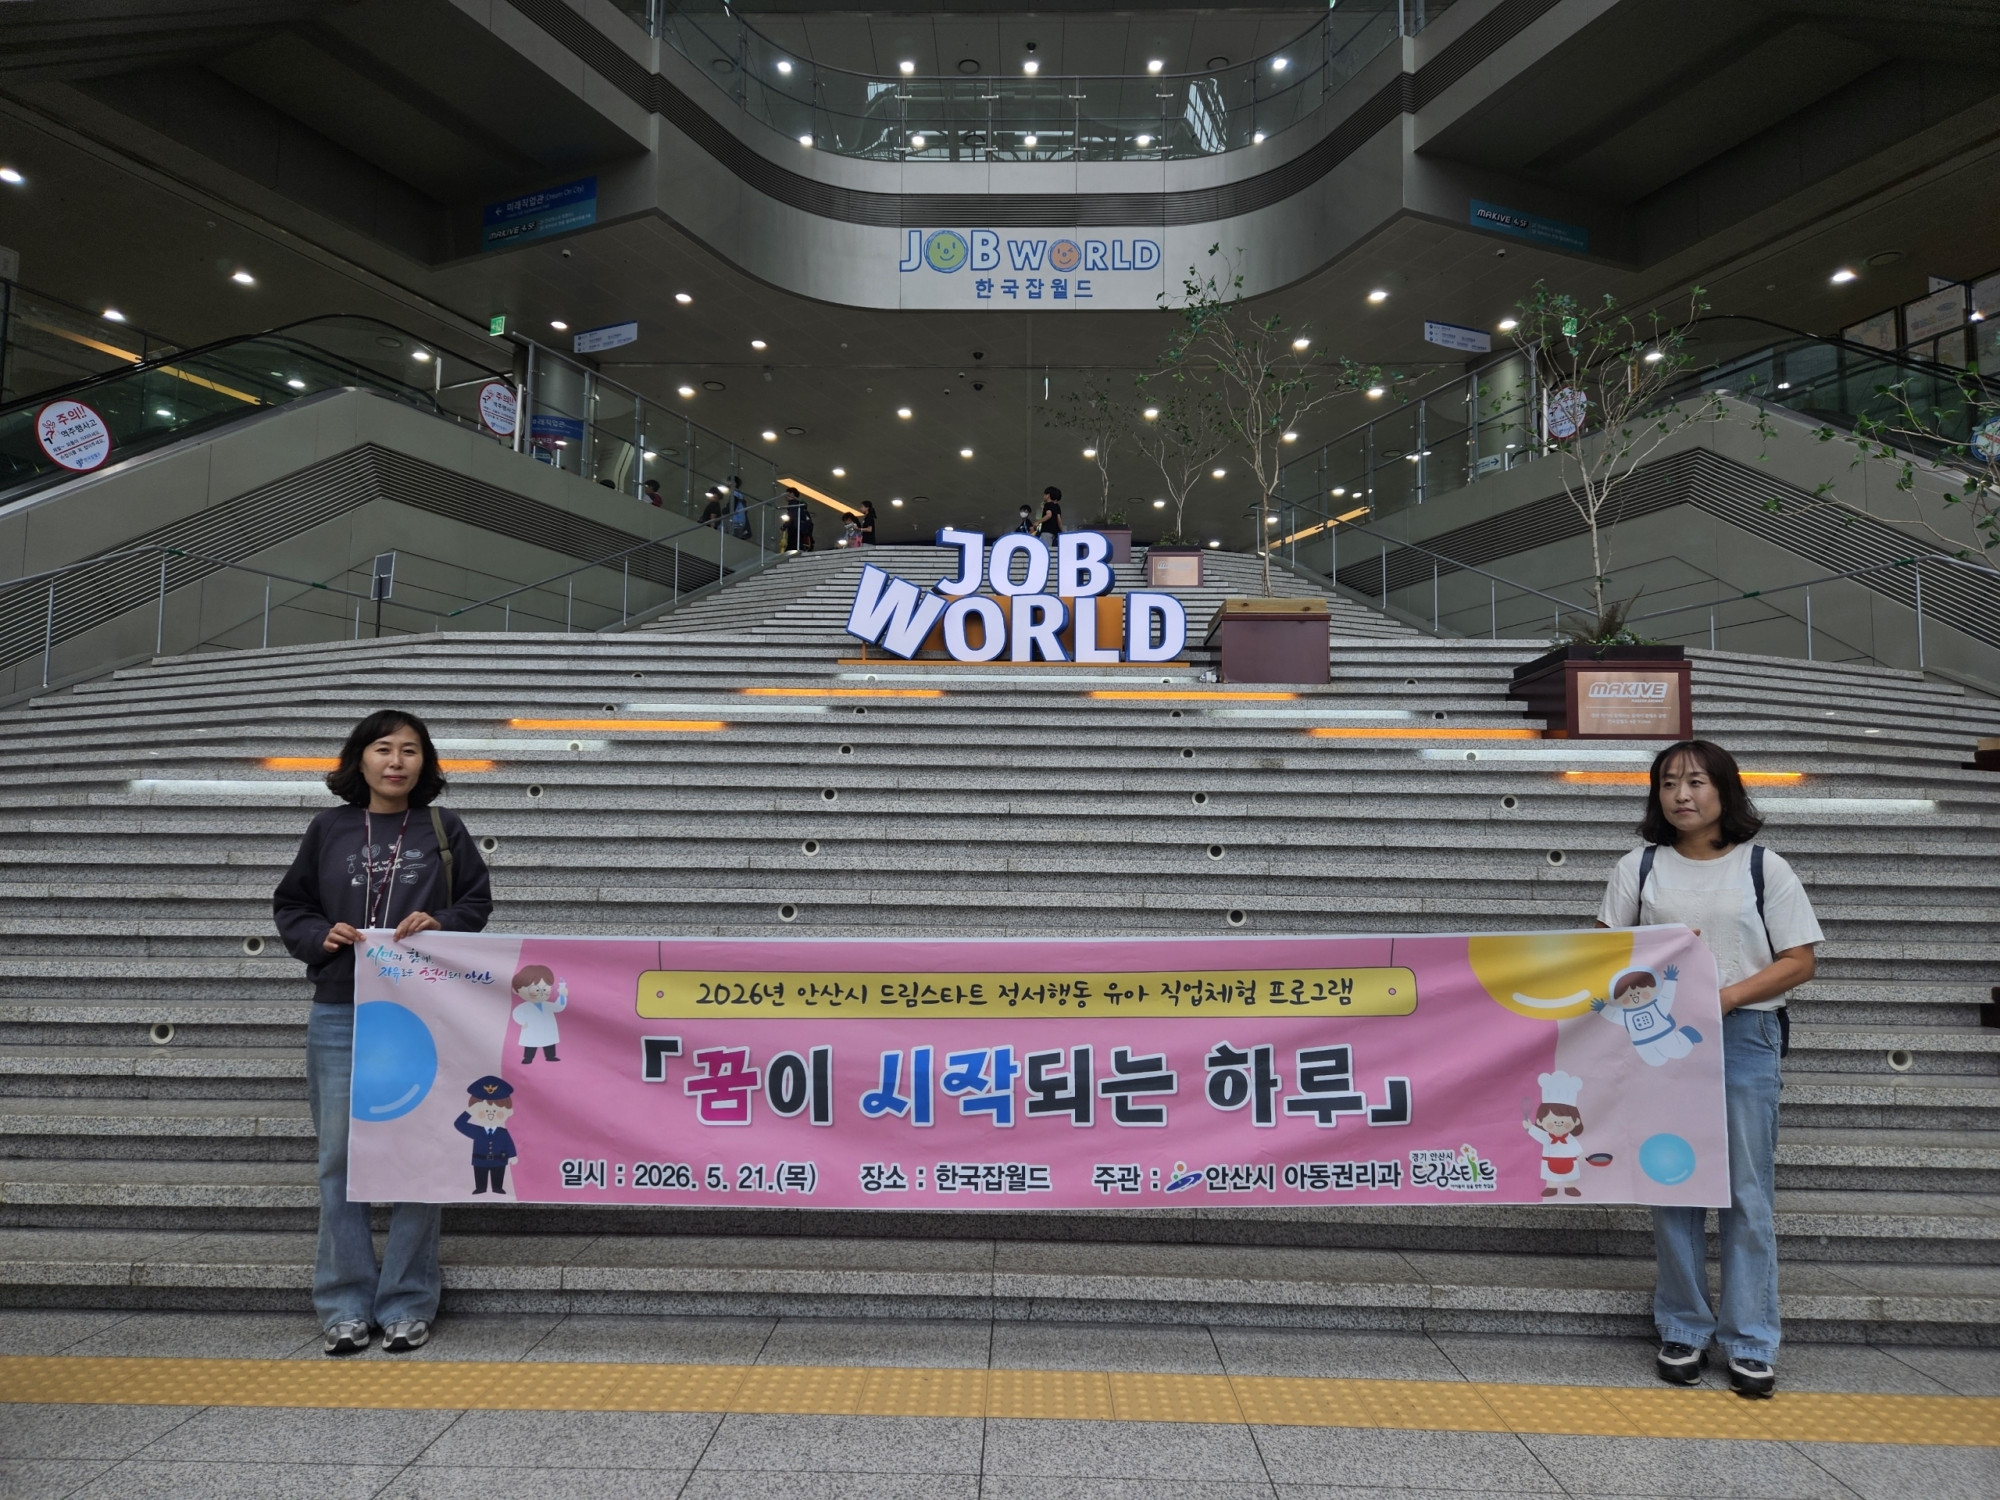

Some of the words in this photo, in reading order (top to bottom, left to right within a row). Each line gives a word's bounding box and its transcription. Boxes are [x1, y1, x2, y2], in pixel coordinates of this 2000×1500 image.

[1477, 209, 1511, 224] MAKIVE
[489, 226, 519, 241] MAKIVE
[899, 229, 1000, 273] JOB
[1007, 239, 1161, 272] WORLD
[975, 278, 1093, 299] 한국잡월드
[56, 405, 87, 425] 주의!!
[61, 419, 97, 437] 역주행사고
[931, 530, 1115, 597] JOB
[846, 563, 1186, 663] WORLD
[1589, 682, 1668, 698] MAKIVE
[366, 945, 405, 966] 시민과
[378, 966, 414, 984] 자유로운
[419, 967, 460, 984] 혁신도시
[464, 970, 495, 984] 안산
[696, 982, 785, 1006] 2026년
[797, 982, 867, 1006] 안산시
[880, 981, 988, 1008] 드림스타트
[998, 981, 1092, 1008] 정서행동
[1104, 981, 1149, 1005] 유아
[1161, 979, 1256, 1006] 직업체험
[1269, 977, 1354, 1005] 프로그램
[859, 1044, 1177, 1127] 시작되는
[1412, 1152, 1427, 1162] 경기
[1430, 1152, 1453, 1161] 안산시
[561, 1161, 605, 1187] 일시
[634, 1164, 697, 1189] 2026.
[707, 1166, 728, 1190] 5.
[738, 1163, 817, 1192] 21.(목)
[860, 1164, 907, 1192] 장소
[935, 1164, 1051, 1192] 한국잡월드
[1094, 1165, 1140, 1193] 주관
[1206, 1164, 1274, 1190] 안산시
[1284, 1161, 1401, 1190] 아동권리과
[1412, 1158, 1494, 1188] 드림스타트
